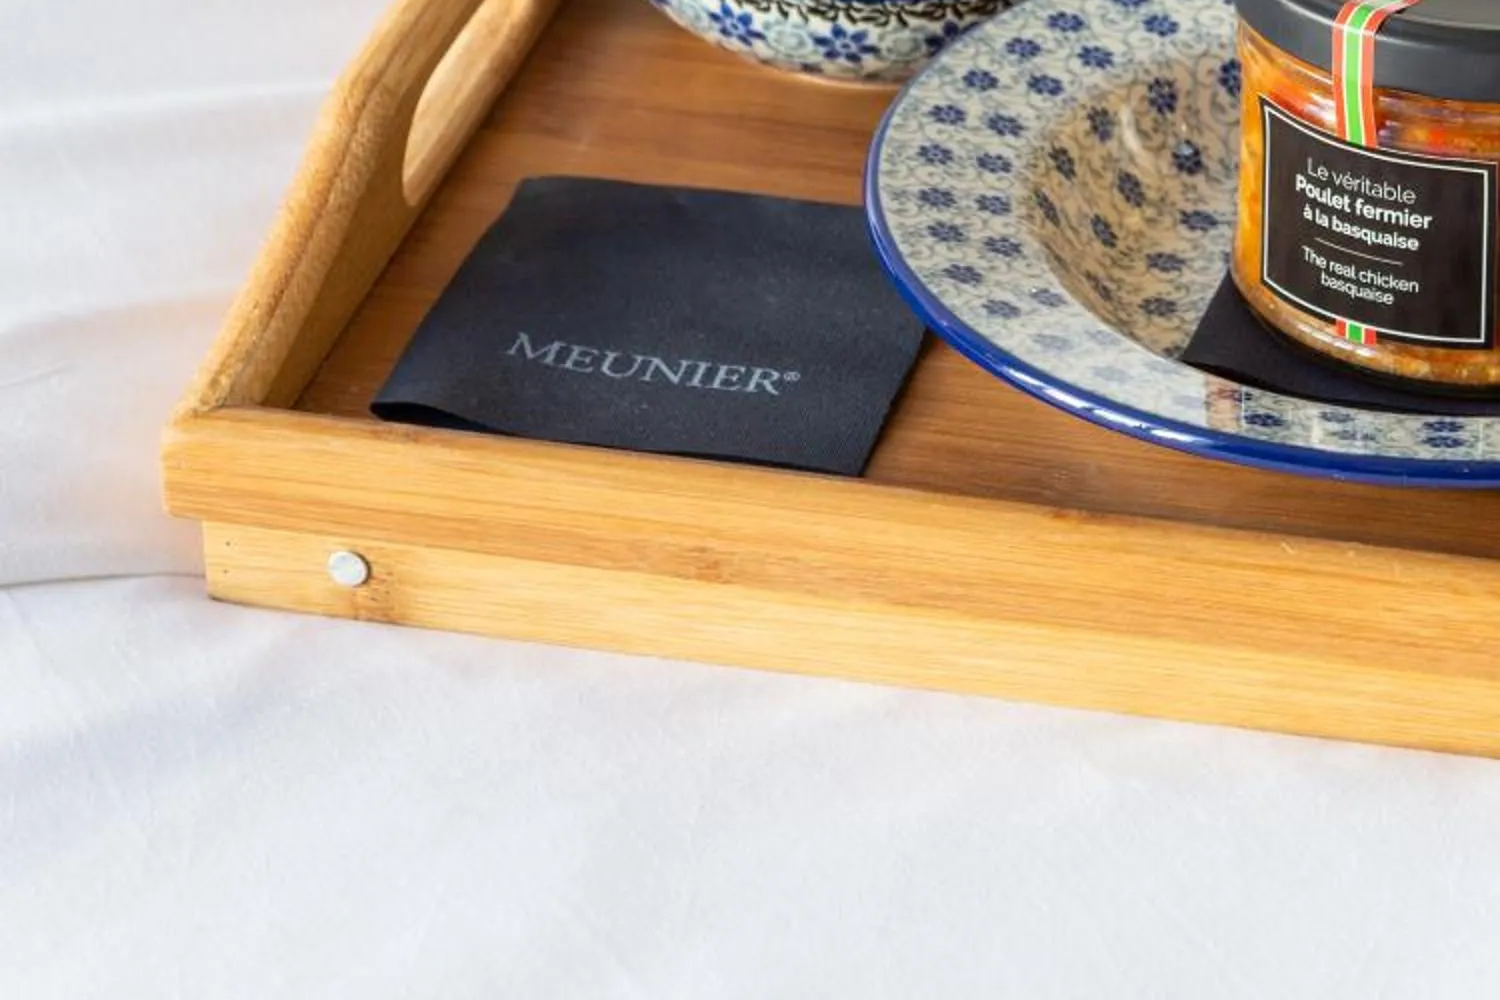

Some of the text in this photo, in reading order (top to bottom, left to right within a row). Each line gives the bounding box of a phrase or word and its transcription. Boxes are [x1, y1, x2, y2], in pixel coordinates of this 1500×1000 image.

[1295, 173, 1432, 229] Poulet fermier
[1307, 157, 1417, 204] Le véritable
[1303, 203, 1419, 250] à la basquaise
[1302, 245, 1419, 292] The real chicken
[1321, 271, 1394, 304] basquaise
